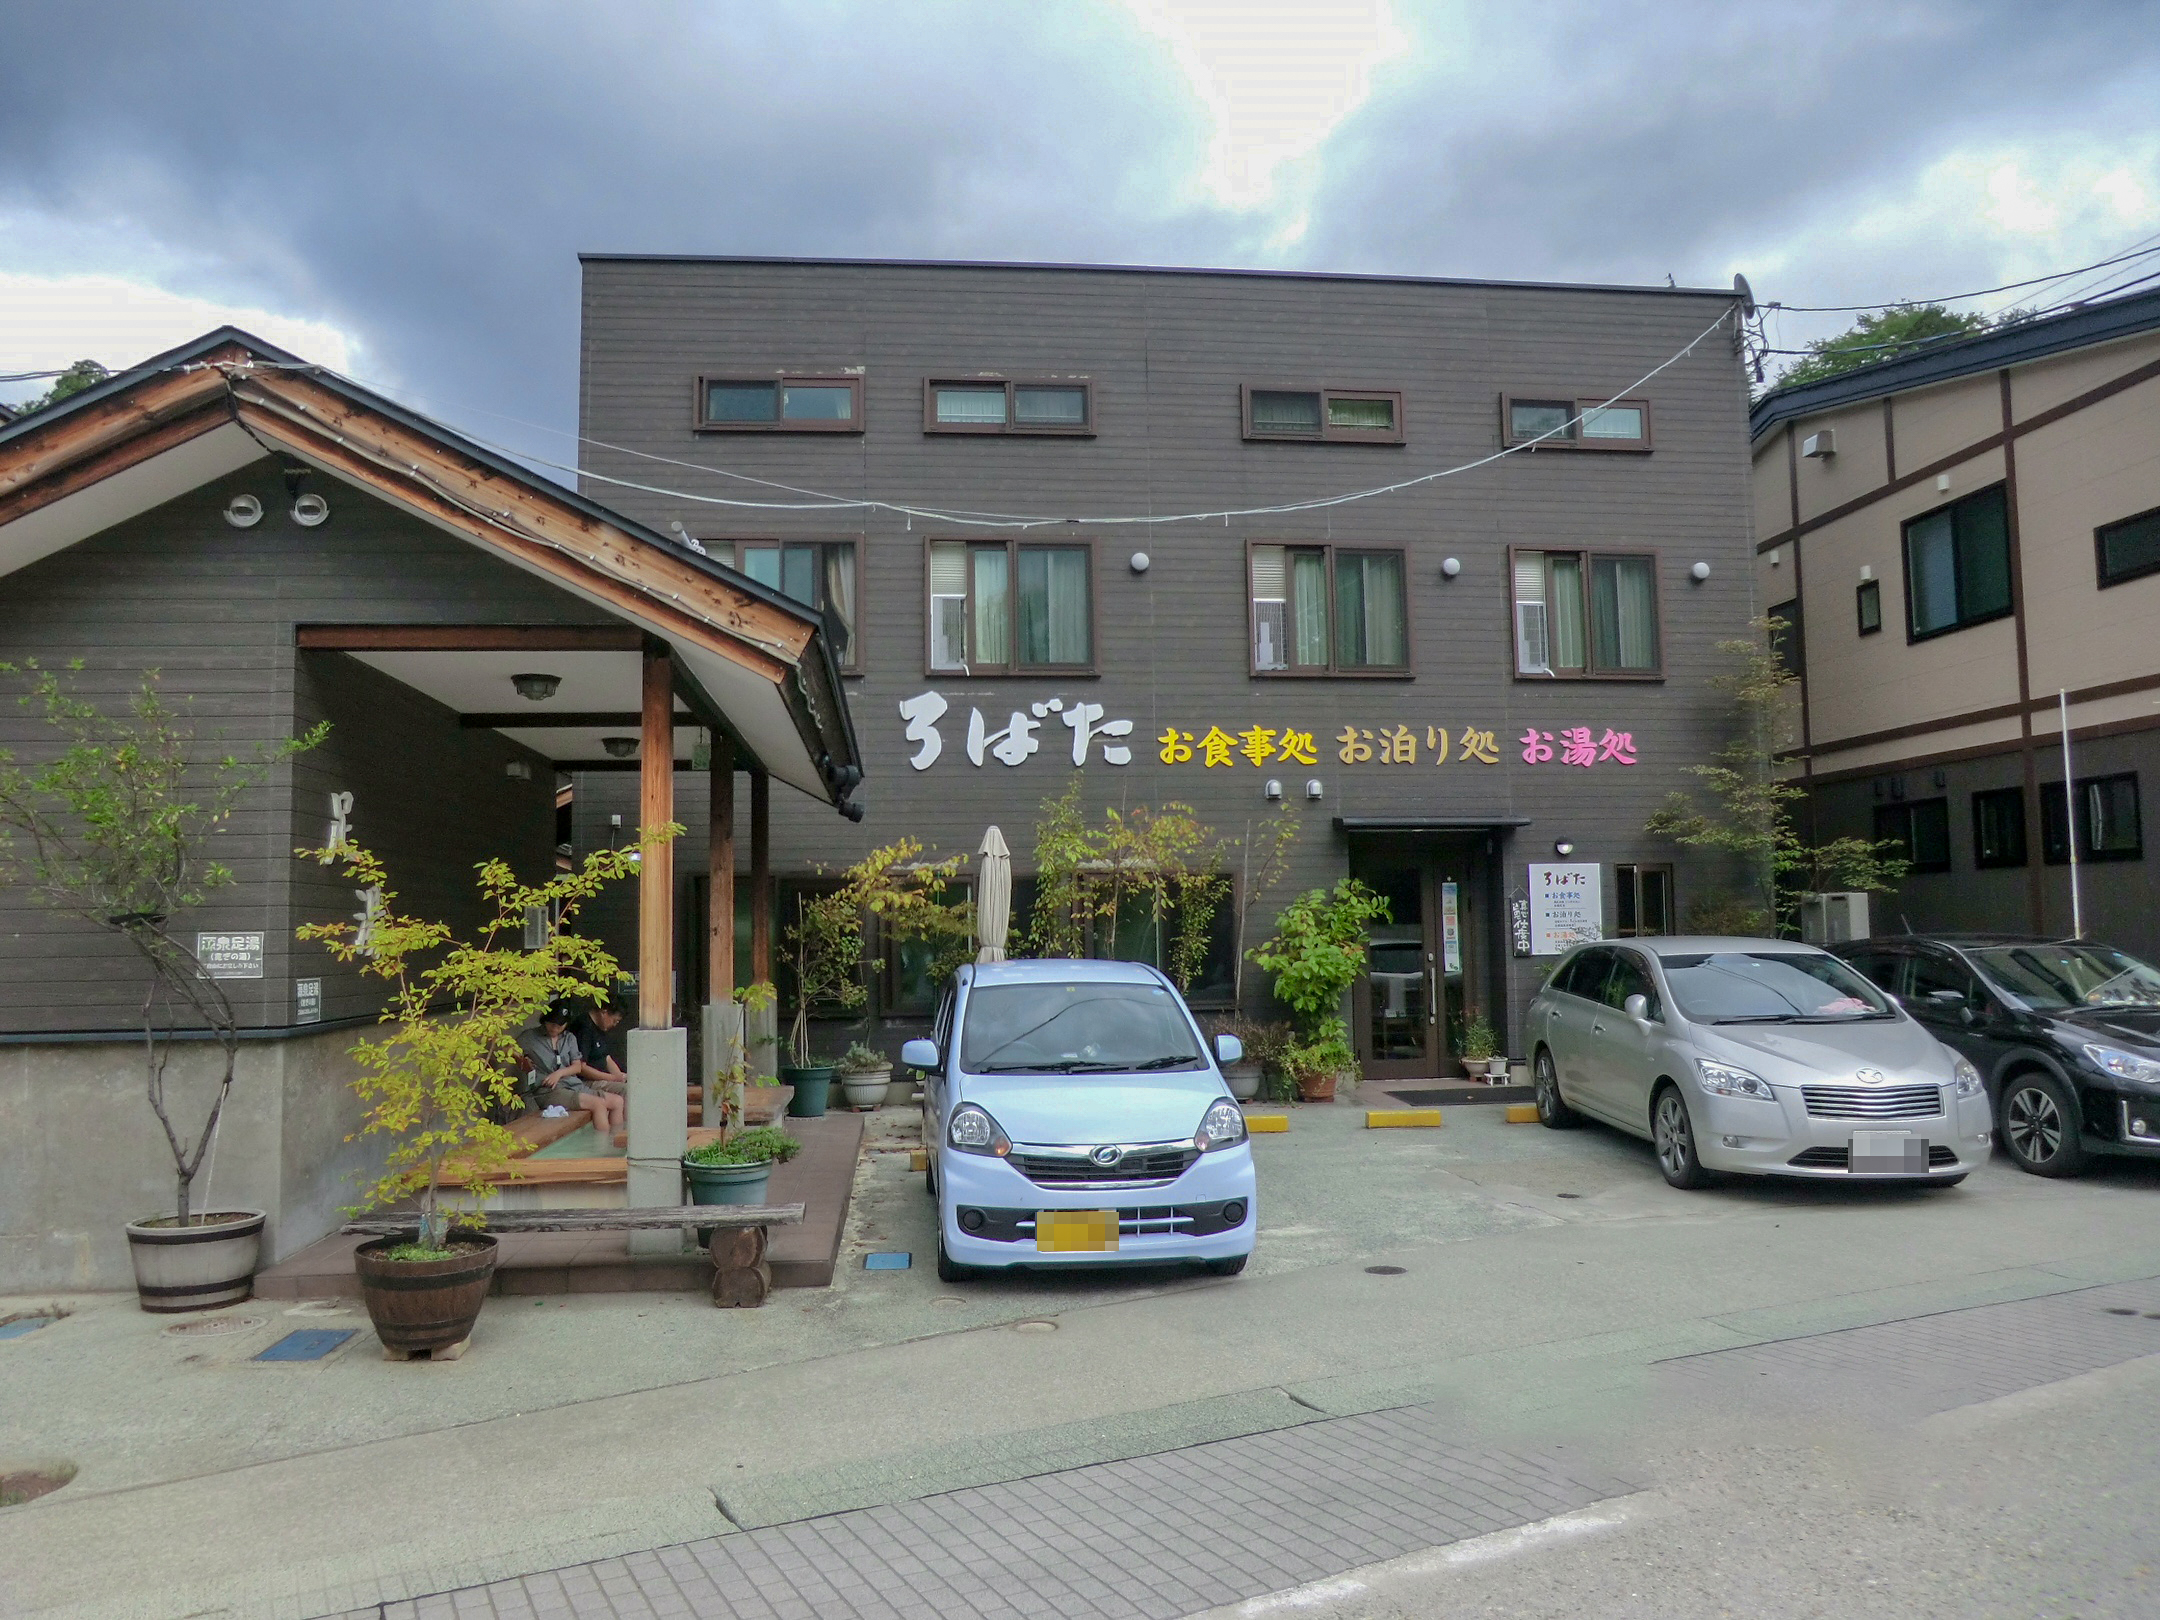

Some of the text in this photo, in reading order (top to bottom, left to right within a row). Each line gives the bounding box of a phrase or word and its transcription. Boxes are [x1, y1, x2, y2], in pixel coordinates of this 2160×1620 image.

[899, 691, 1638, 770] ろばた お食事処 お泊り処 お湯処
[1543, 871, 1586, 886] ろばた
[1552, 891, 1581, 900] お食事処
[1552, 910, 1582, 918] お泊り処
[201, 936, 260, 951] 源泉足湯
